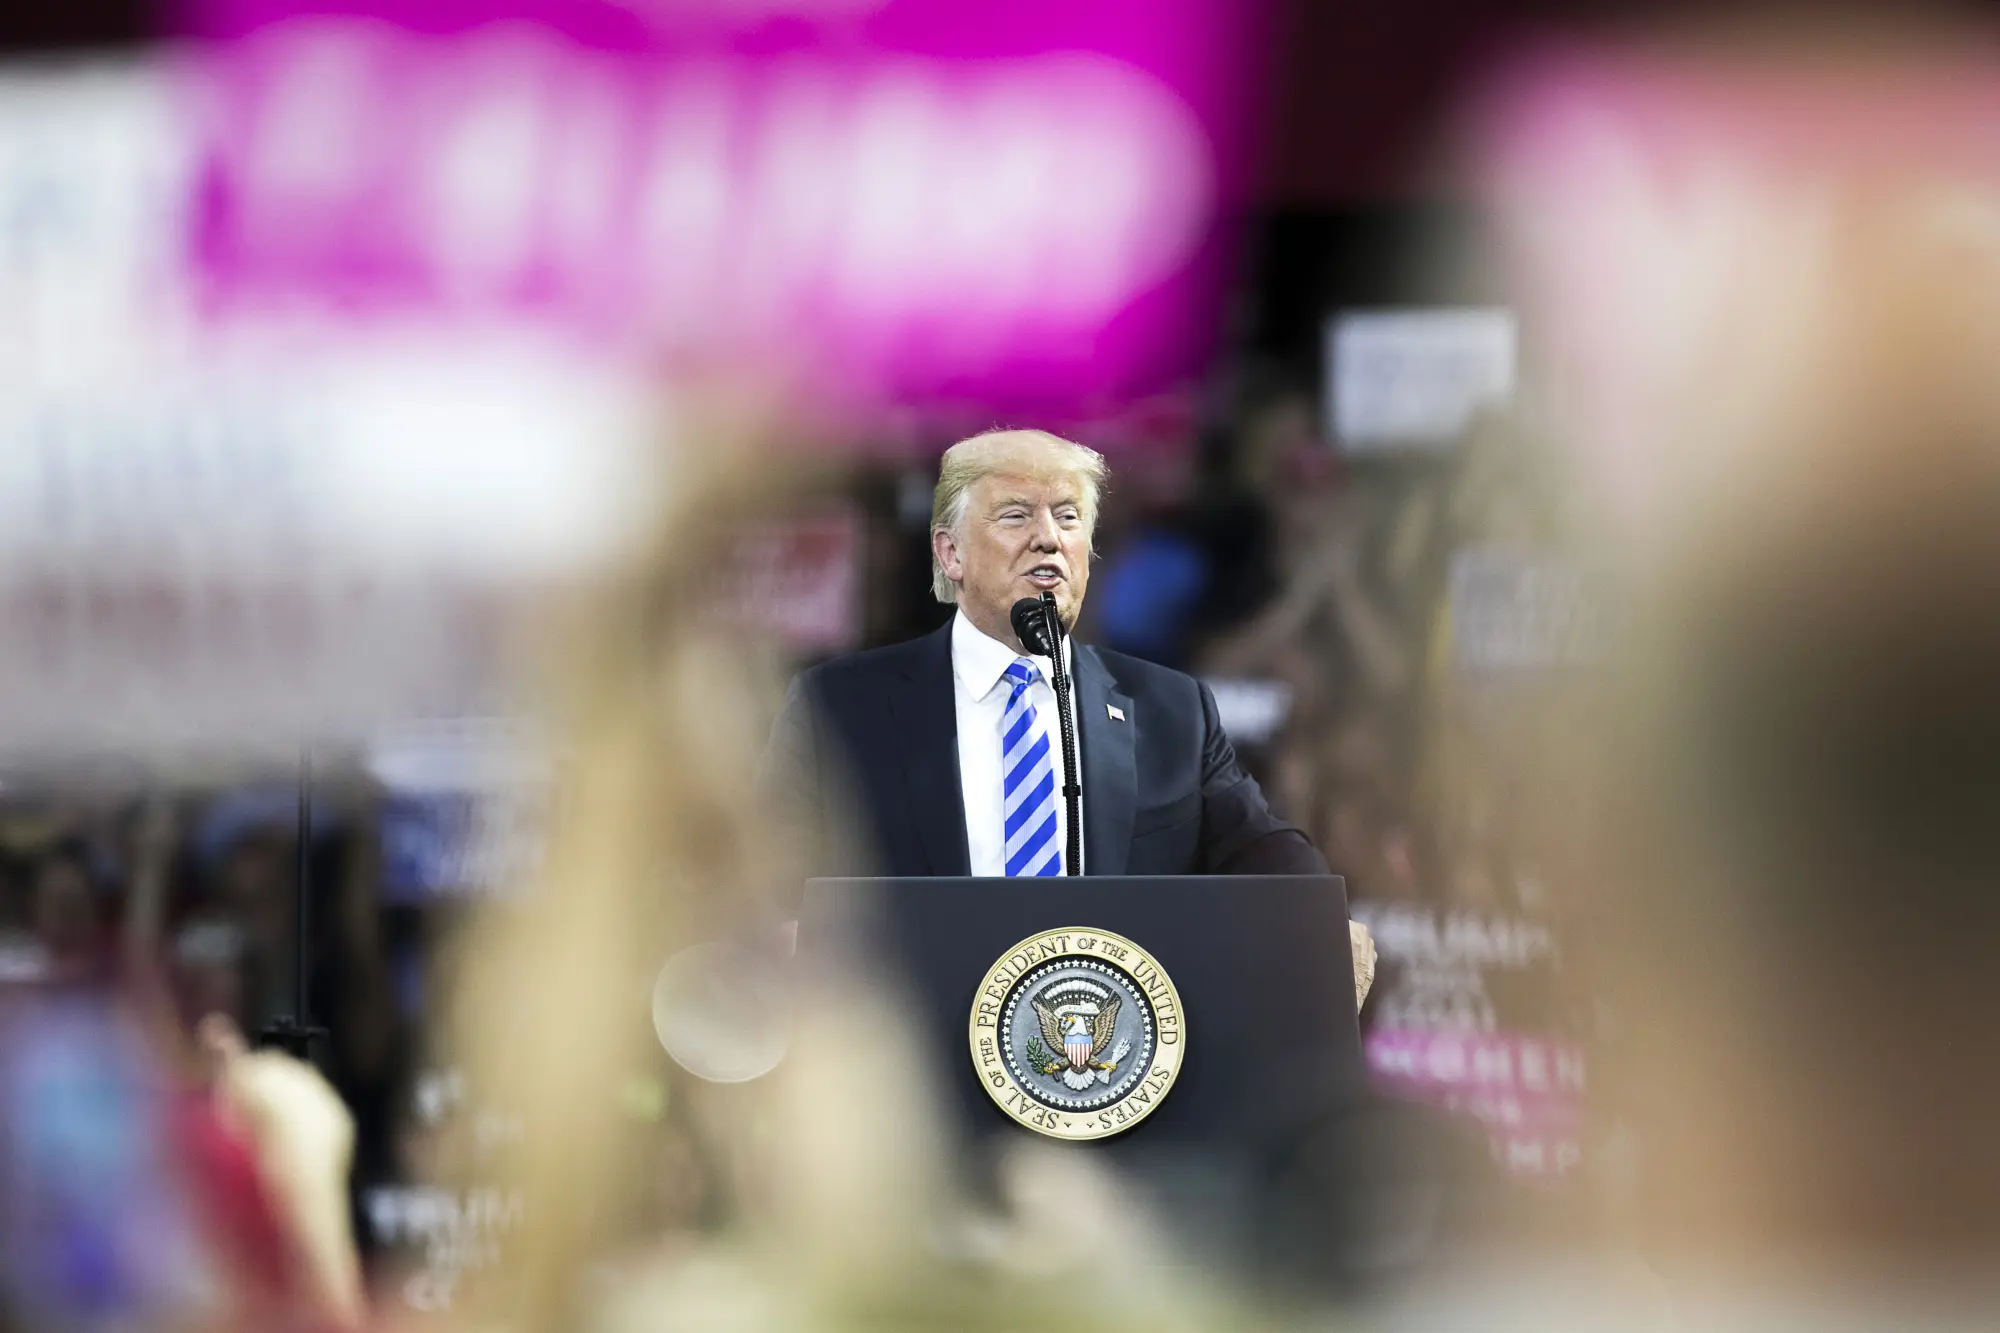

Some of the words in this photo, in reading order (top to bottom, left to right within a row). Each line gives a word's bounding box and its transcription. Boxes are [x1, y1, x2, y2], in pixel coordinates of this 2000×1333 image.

[1077, 937, 1098, 950] OF
[1101, 941, 1128, 962] THE
[977, 935, 1070, 1029] PRESIDENT
[1132, 958, 1178, 1045] UNITED
[979, 1036, 997, 1067] THE
[989, 1069, 1006, 1088] OF
[1098, 1065, 1170, 1130] STATES
[1006, 1085, 1060, 1130] SEAL
